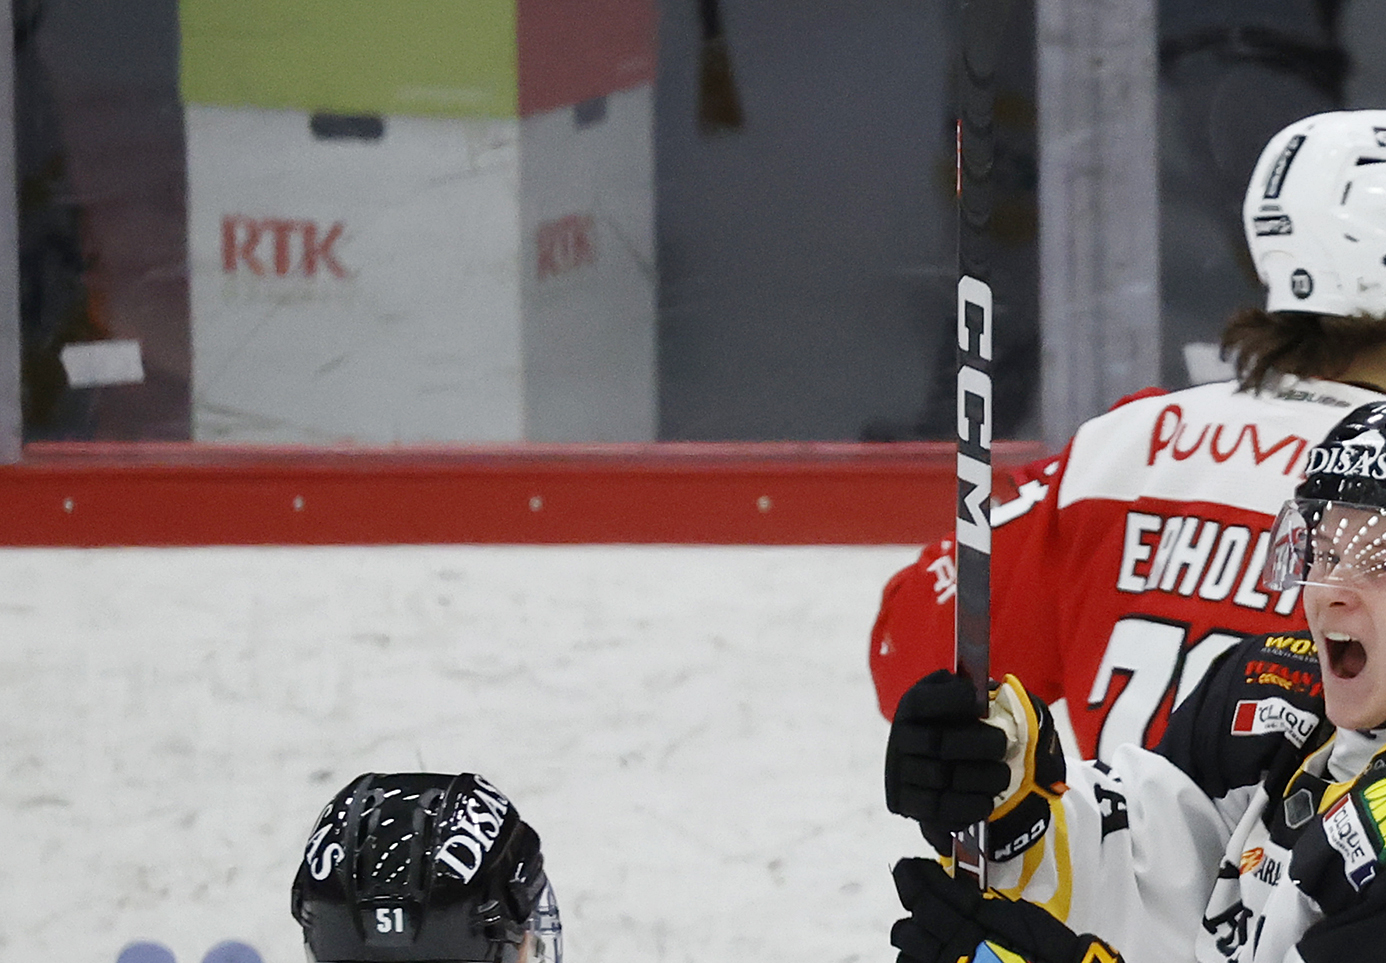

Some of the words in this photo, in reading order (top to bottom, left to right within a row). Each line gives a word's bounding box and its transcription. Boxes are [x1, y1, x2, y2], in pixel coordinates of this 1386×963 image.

[221, 213, 353, 281] RTK
[535, 214, 595, 281] RTK
[955, 274, 993, 556] CCM
[375, 907, 404, 933] 51
